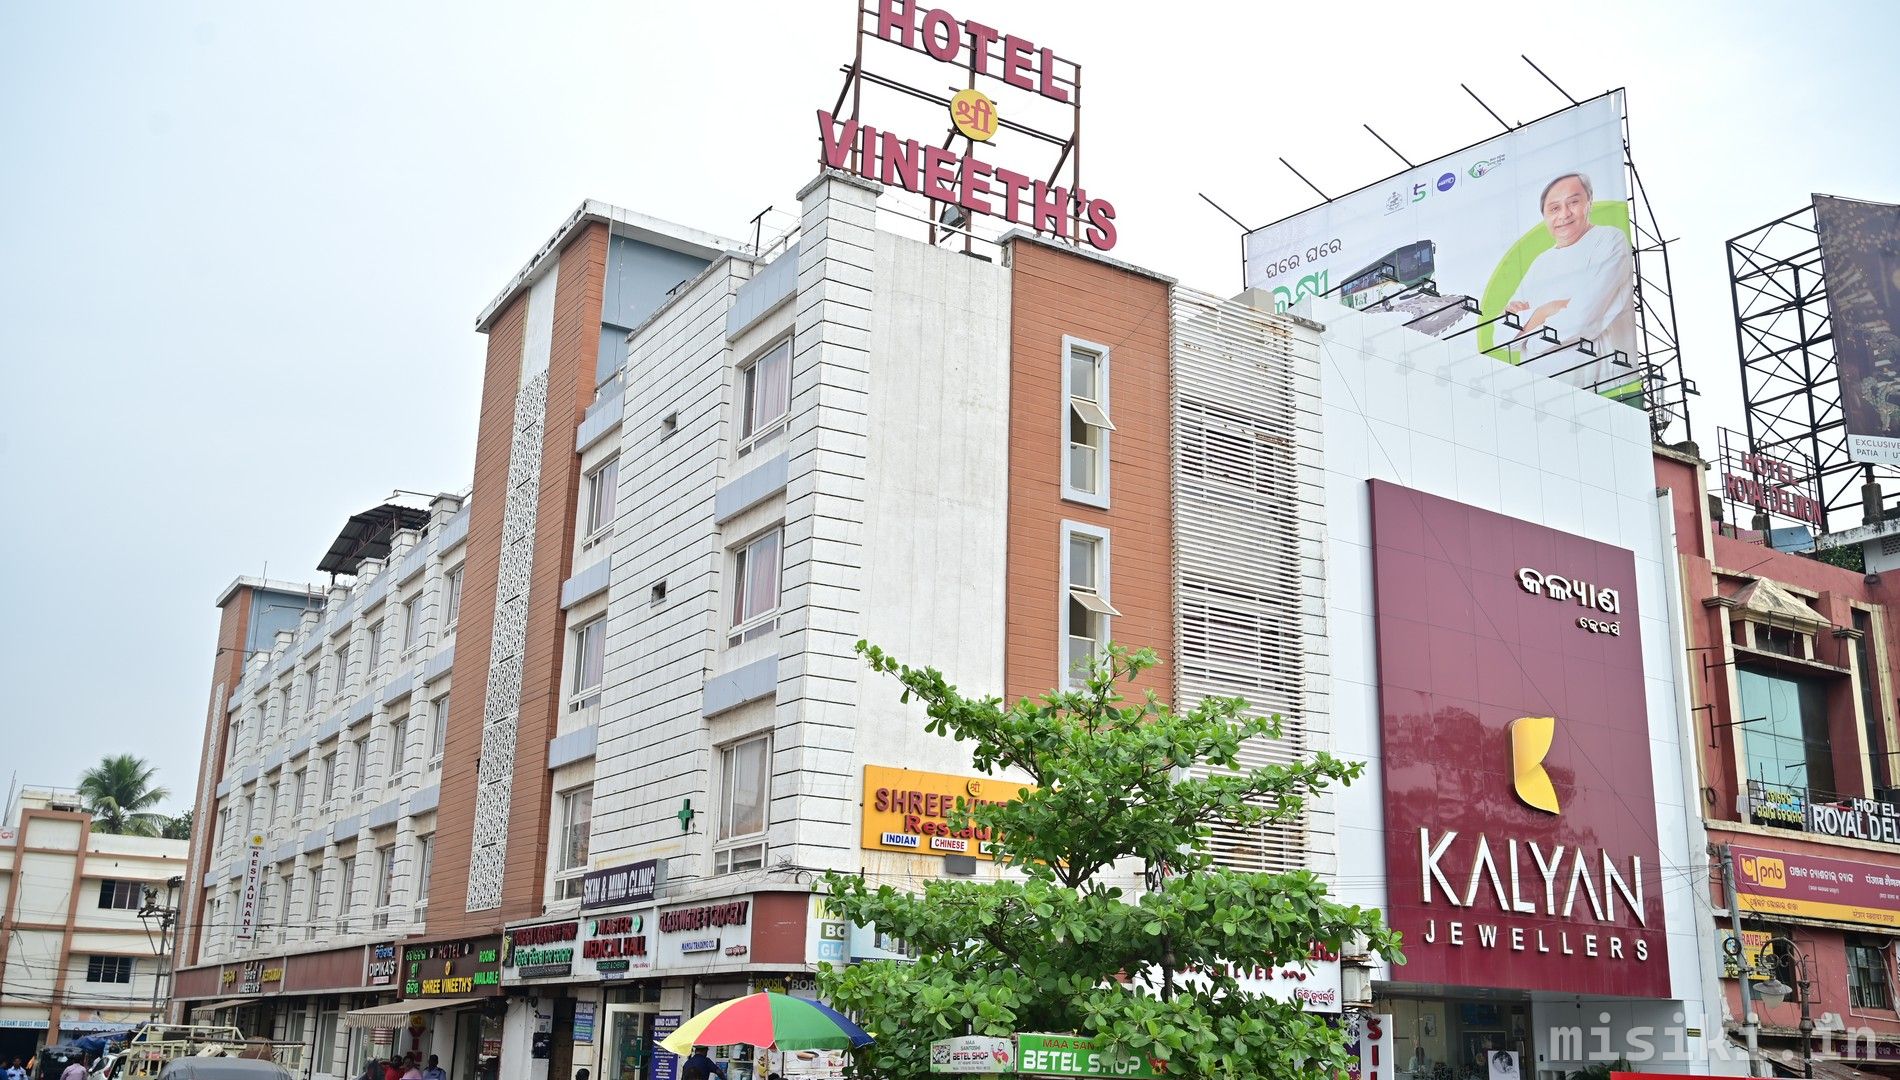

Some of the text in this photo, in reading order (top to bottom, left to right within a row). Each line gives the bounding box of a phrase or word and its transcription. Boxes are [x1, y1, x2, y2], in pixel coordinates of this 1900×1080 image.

[879, 0, 1068, 103] HOTEL
[955, 98, 993, 135] श्री
[817, 109, 1117, 250] VINEETH'S
[1266, 238, 1342, 279] ଘରେ ଘରେ
[1856, 448, 1879, 457] PATIA
[1741, 451, 1799, 486] HOTEL
[1725, 472, 1769, 510] ROYAL
[875, 788, 954, 818] SHREE
[1853, 797, 1900, 817] HOTEL
[1812, 804, 1868, 839] ROYAL
[885, 834, 917, 846] INDIAN
[934, 838, 965, 850] CHINESE
[583, 866, 656, 904] SKIN & MIND CLINIC
[1419, 827, 1646, 927] KALYAN
[1759, 865, 1783, 883] pnb
[243, 851, 259, 934] RESTAURANT
[599, 914, 632, 935] MASTER
[583, 938, 623, 958] MEDICAL
[623, 935, 647, 957] HALL
[1425, 919, 1648, 961] JEWELLERS
[1741, 932, 1770, 946] RAVELS
[479, 949, 496, 963] ROOMS
[421, 979, 441, 994] SHREE
[441, 977, 472, 993] VINEETH'S
[473, 971, 499, 985] AVAILABLE
[791, 980, 822, 991] BOR
[952, 1051, 989, 1061] BETEL SHOP
[1043, 1039, 1096, 1051] MAA SAN
[1023, 1049, 1141, 1075] BETEL SOP
